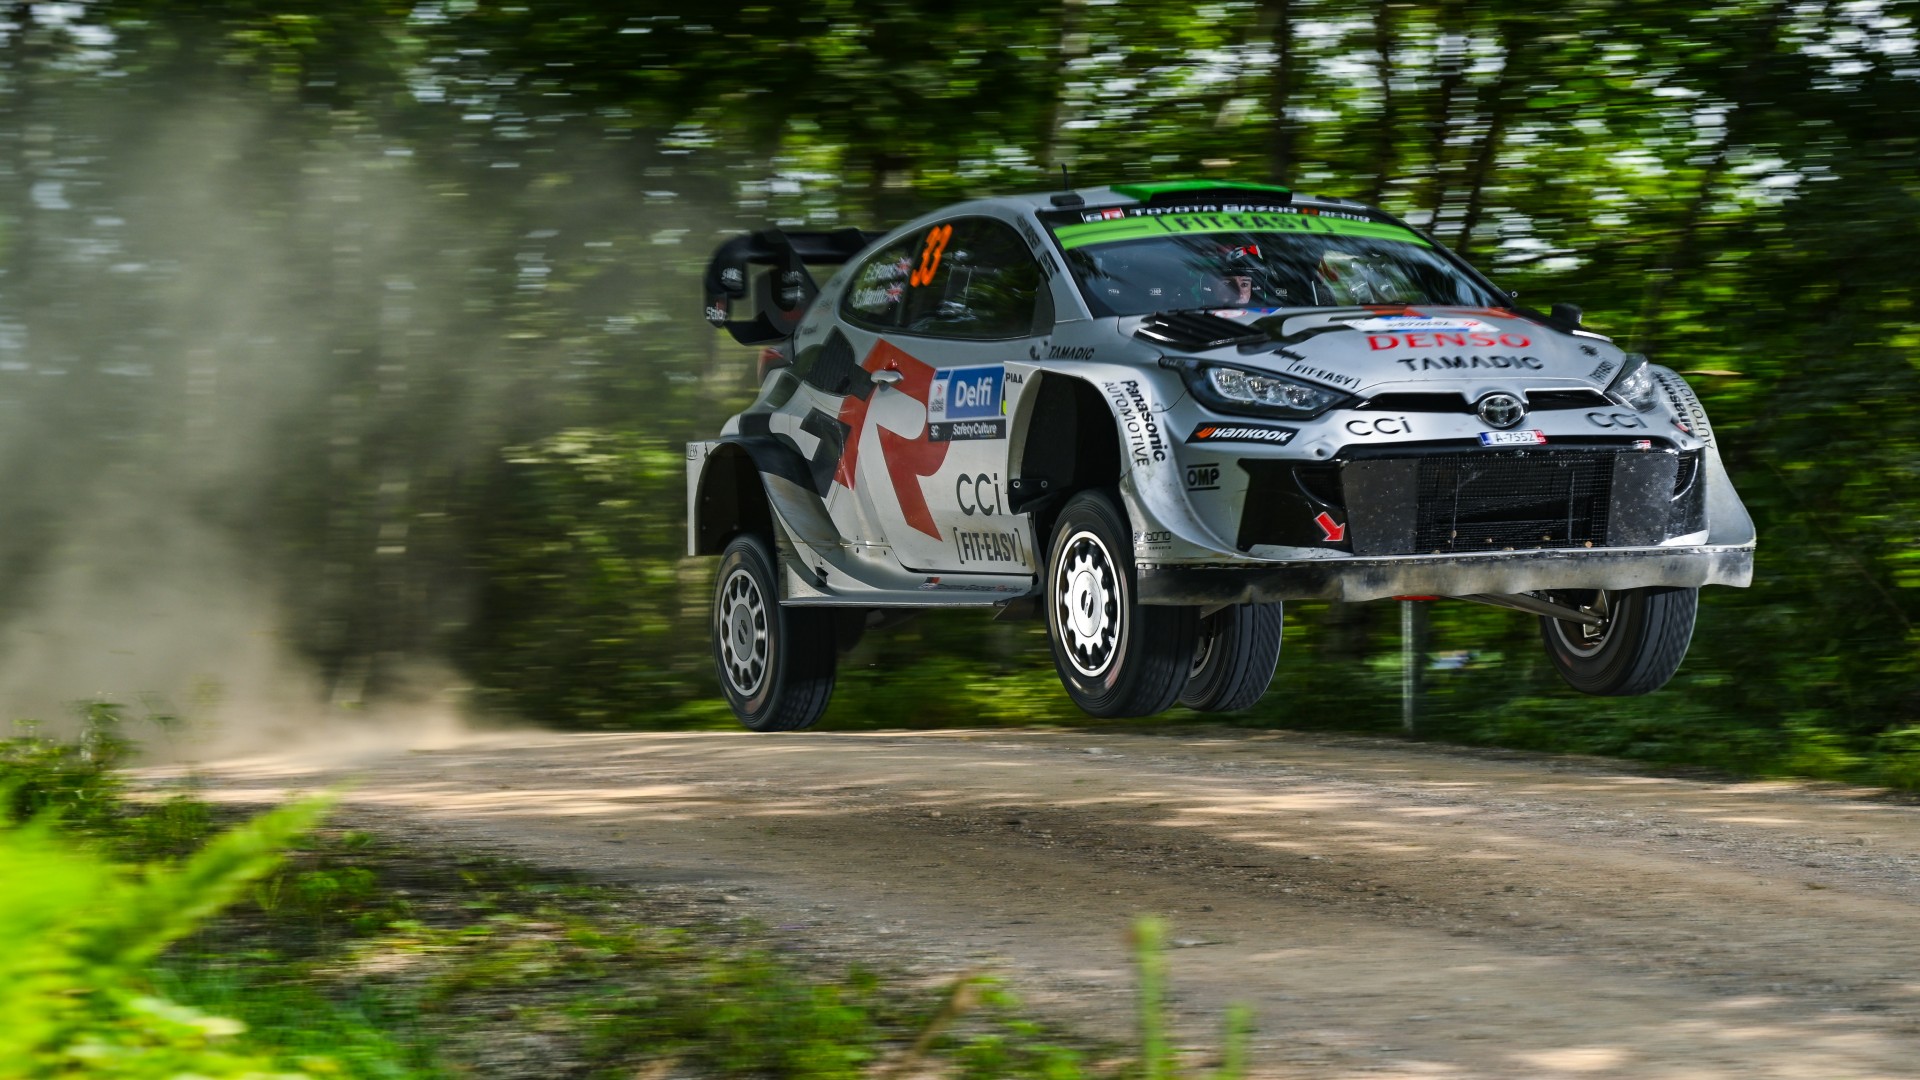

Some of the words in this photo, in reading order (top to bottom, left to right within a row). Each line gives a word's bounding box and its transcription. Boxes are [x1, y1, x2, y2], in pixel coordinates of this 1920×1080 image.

[910, 224, 953, 288] 33
[1367, 333, 1532, 351] DENSO
[1049, 345, 1095, 361] TAMADIC
[1398, 356, 1544, 372] TAMADIC
[1005, 373, 1024, 385] PIAA
[955, 376, 994, 408] Delfi
[1102, 382, 1150, 467] AUTOMOTIVE
[1120, 380, 1168, 462] Panasonic
[1187, 467, 1220, 488] OMP
